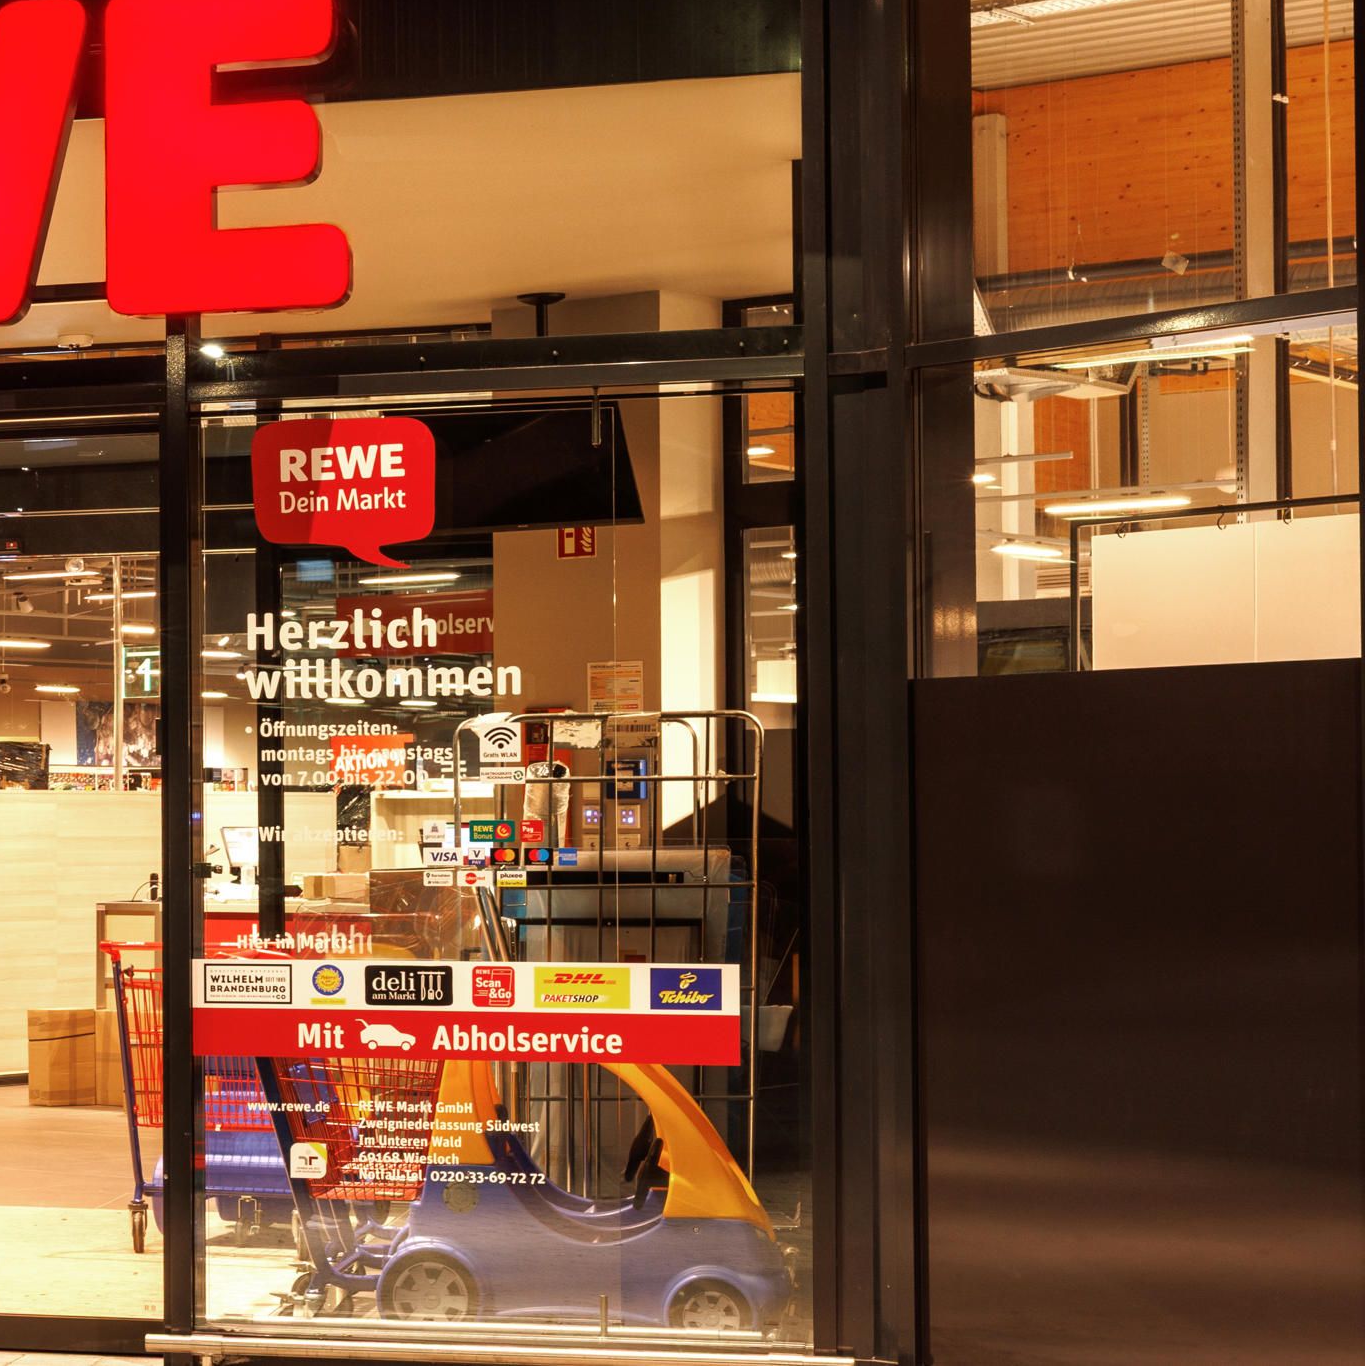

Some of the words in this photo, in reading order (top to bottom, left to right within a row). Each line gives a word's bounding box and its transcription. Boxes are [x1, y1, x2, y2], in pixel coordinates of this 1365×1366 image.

[279, 443, 406, 483] REWE
[279, 491, 330, 515] Dein
[336, 487, 407, 512] Markt
[245, 607, 437, 651] Herzlich
[245, 657, 522, 700] willkommen
[260, 718, 398, 741] Öffnungszeiten:
[261, 746, 334, 765] montags
[261, 772, 293, 786] von
[298, 771, 338, 786] 7.00
[345, 770, 370, 786] bis
[375, 770, 429, 785] 22.00
[259, 826, 284, 842] Wir
[473, 825, 494, 833] REWE
[430, 852, 458, 862] VISA
[473, 850, 481, 858] V
[237, 934, 269, 949] Hier
[210, 975, 263, 983] WILHELM
[371, 971, 415, 992] deli
[475, 977, 501, 988] Scan
[554, 973, 606, 984] DHL
[210, 985, 286, 993] BRANDENBURG
[388, 991, 416, 1000] Markt
[489, 988, 512, 999] &Go
[543, 994, 599, 1003] PAKETSHOP
[658, 990, 714, 1004] Tchibo
[298, 1021, 345, 1049] Mit
[433, 1024, 623, 1055] Abholservice
[247, 1100, 331, 1113] www.rewe.de
[358, 1100, 393, 1113] REWE
[397, 1100, 433, 1113] Markt
[435, 1101, 473, 1114] GmbH
[358, 1117, 483, 1134] Zweigniederlassung
[485, 1118, 540, 1132] Südwest
[359, 1134, 374, 1147] Im
[378, 1134, 428, 1147] Unteren
[432, 1135, 462, 1148] Wald
[358, 1152, 400, 1164] 69168
[403, 1152, 460, 1165] Wiesloch
[430, 1171, 527, 1184] 0220-33-69-72
[530, 1172, 546, 1184] 72
